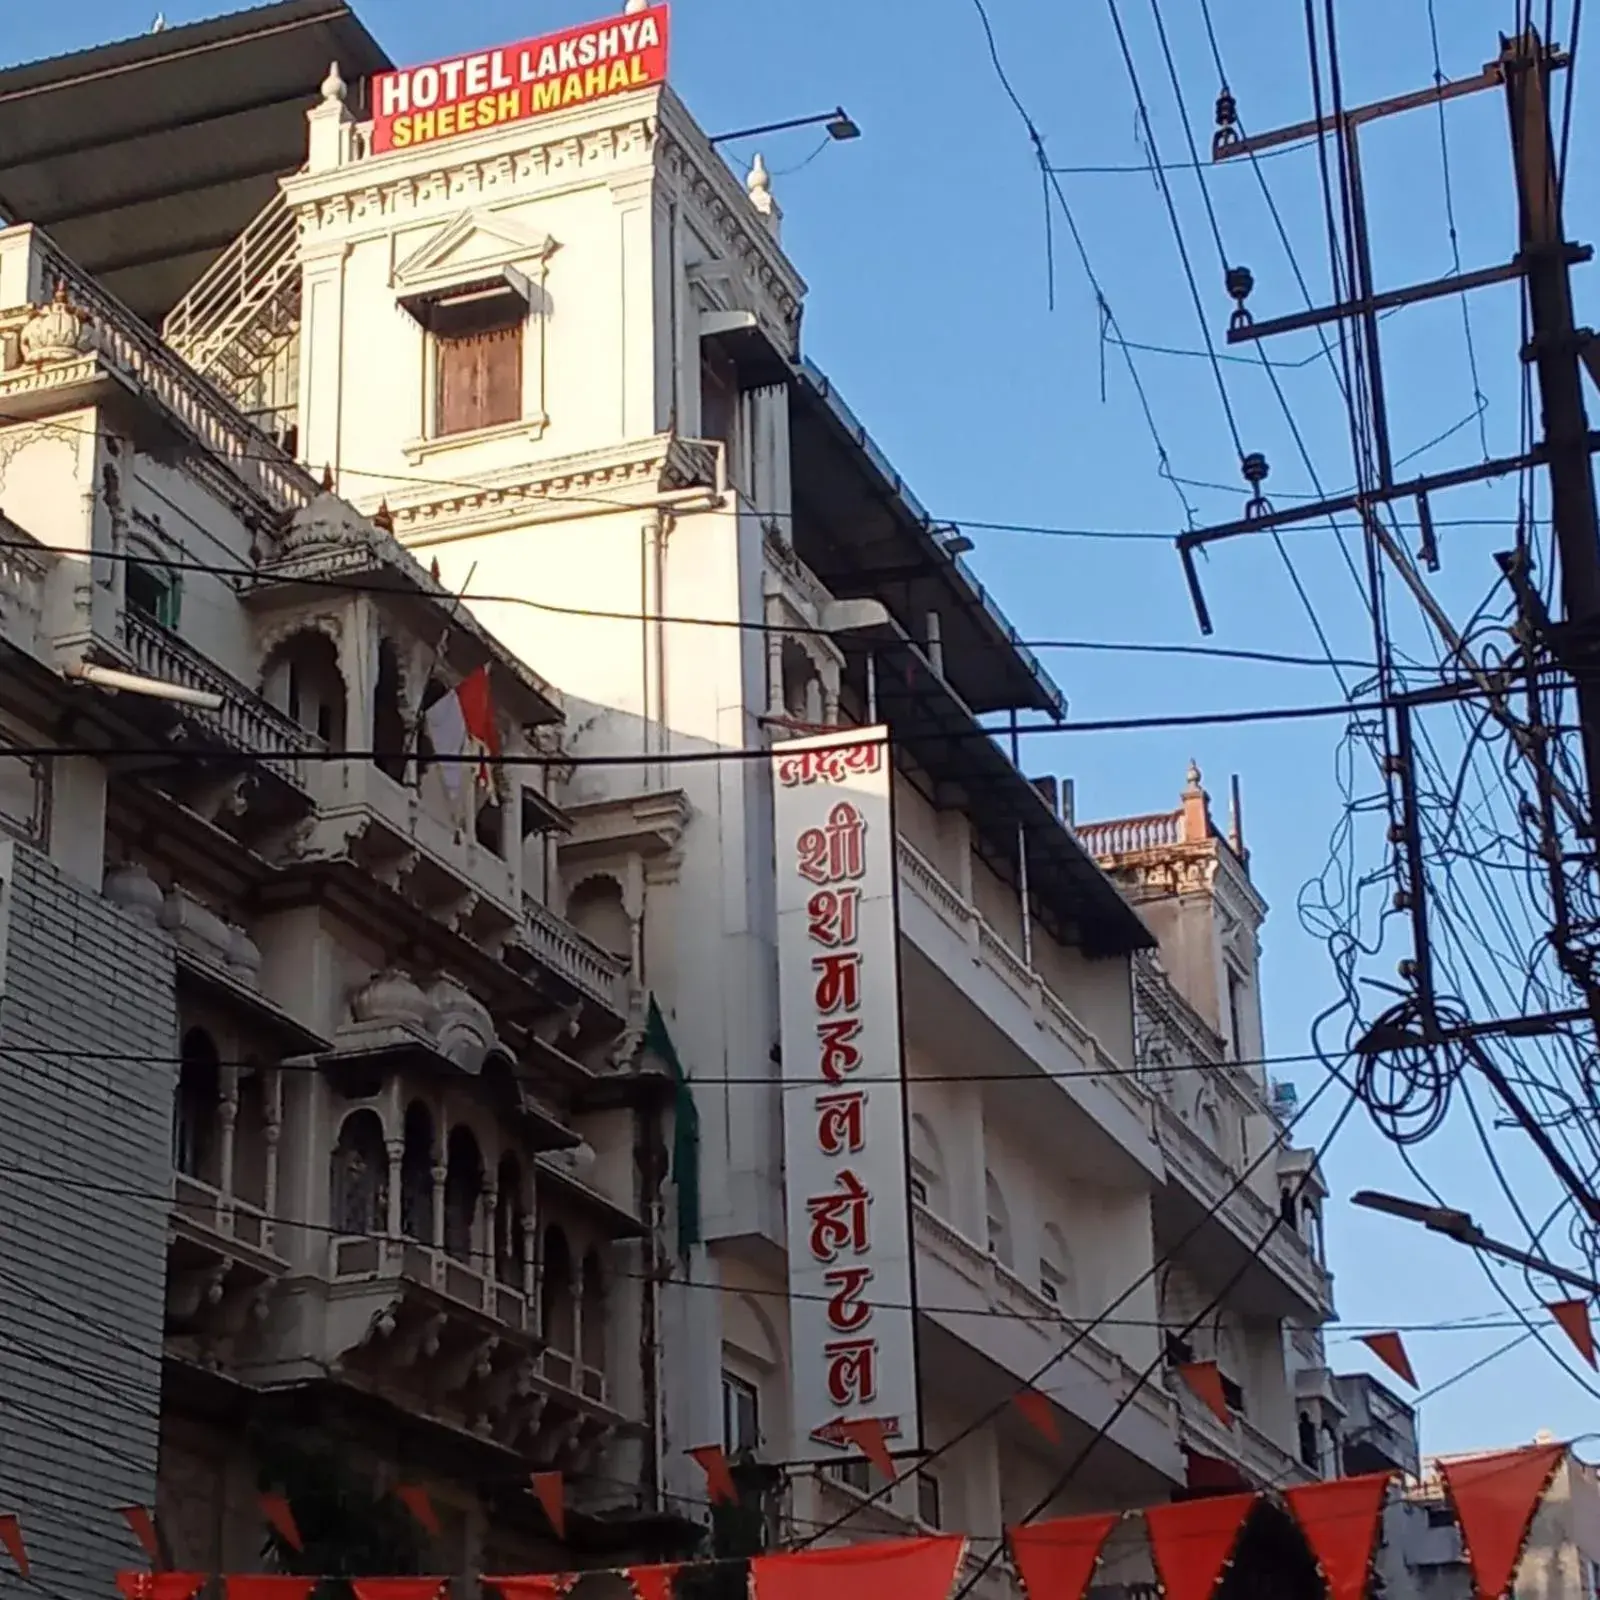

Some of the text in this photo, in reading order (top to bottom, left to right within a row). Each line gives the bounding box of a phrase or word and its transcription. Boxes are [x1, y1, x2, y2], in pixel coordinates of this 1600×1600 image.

[382, 16, 659, 116] HOTEL LAKSHYA
[391, 54, 649, 149] SHEESH MAHAL
